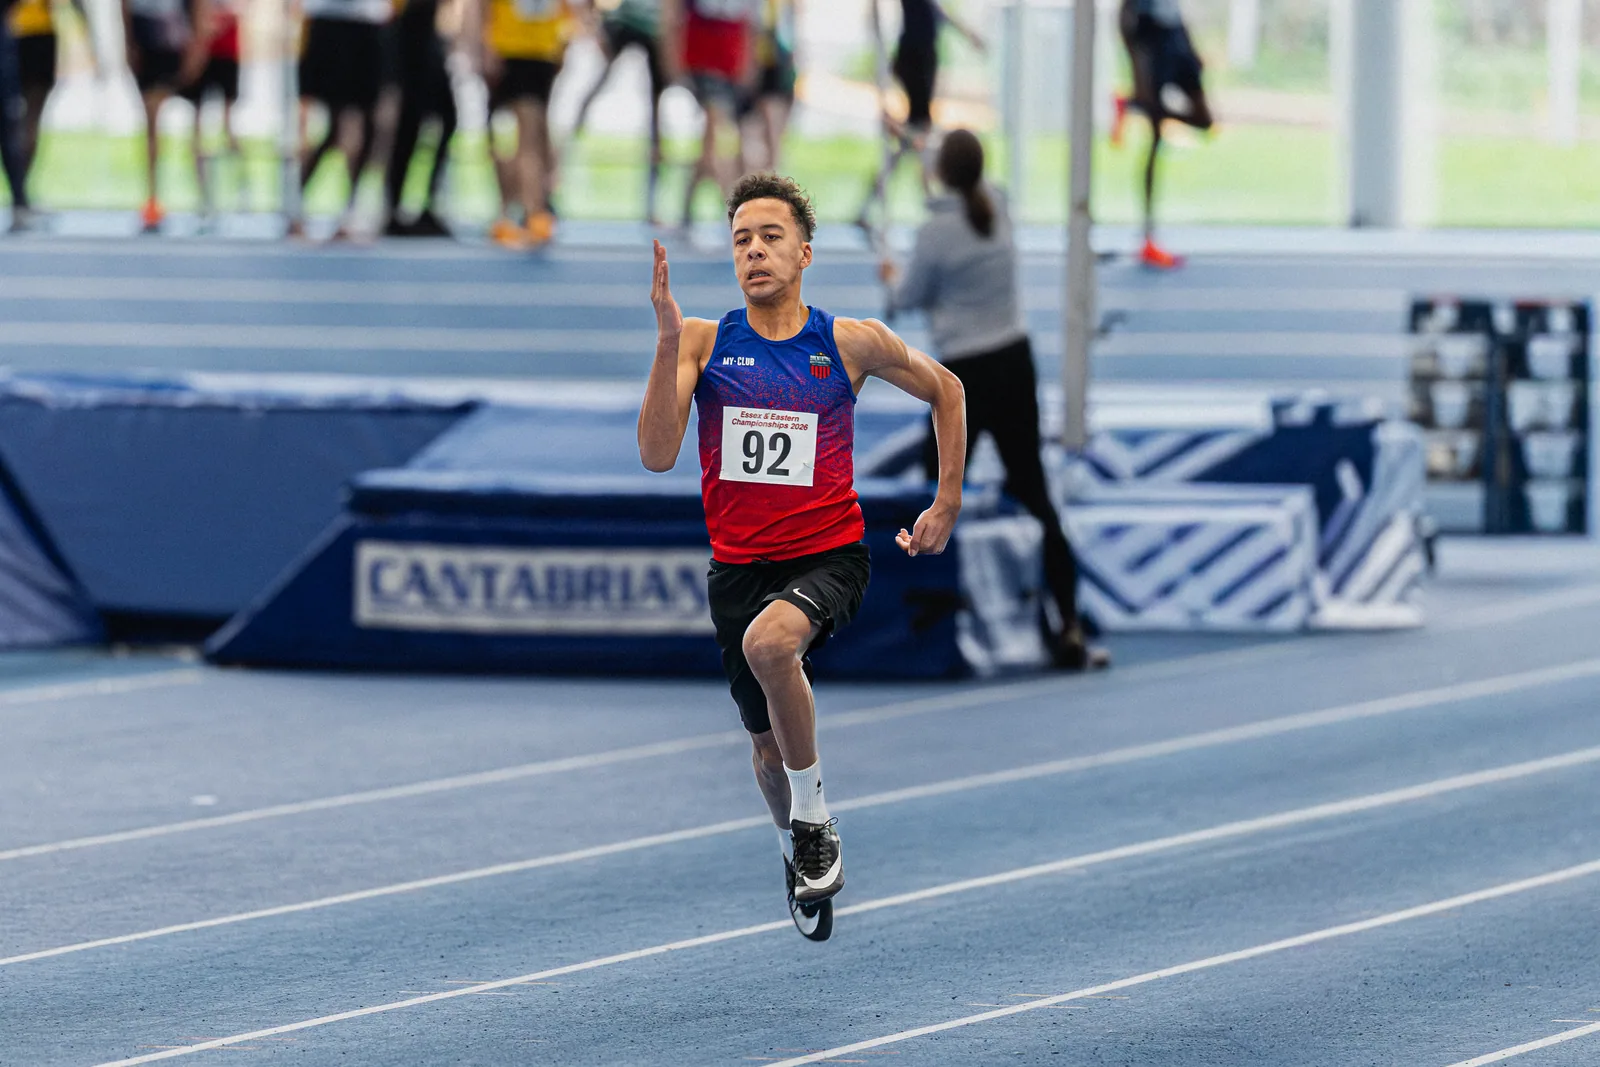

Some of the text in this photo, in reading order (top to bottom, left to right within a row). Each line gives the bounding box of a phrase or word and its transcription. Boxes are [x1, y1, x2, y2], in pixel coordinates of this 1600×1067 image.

[740, 411, 800, 422] Essex & Eastern
[731, 418, 809, 431] Championships 2026
[742, 430, 792, 477] 92
